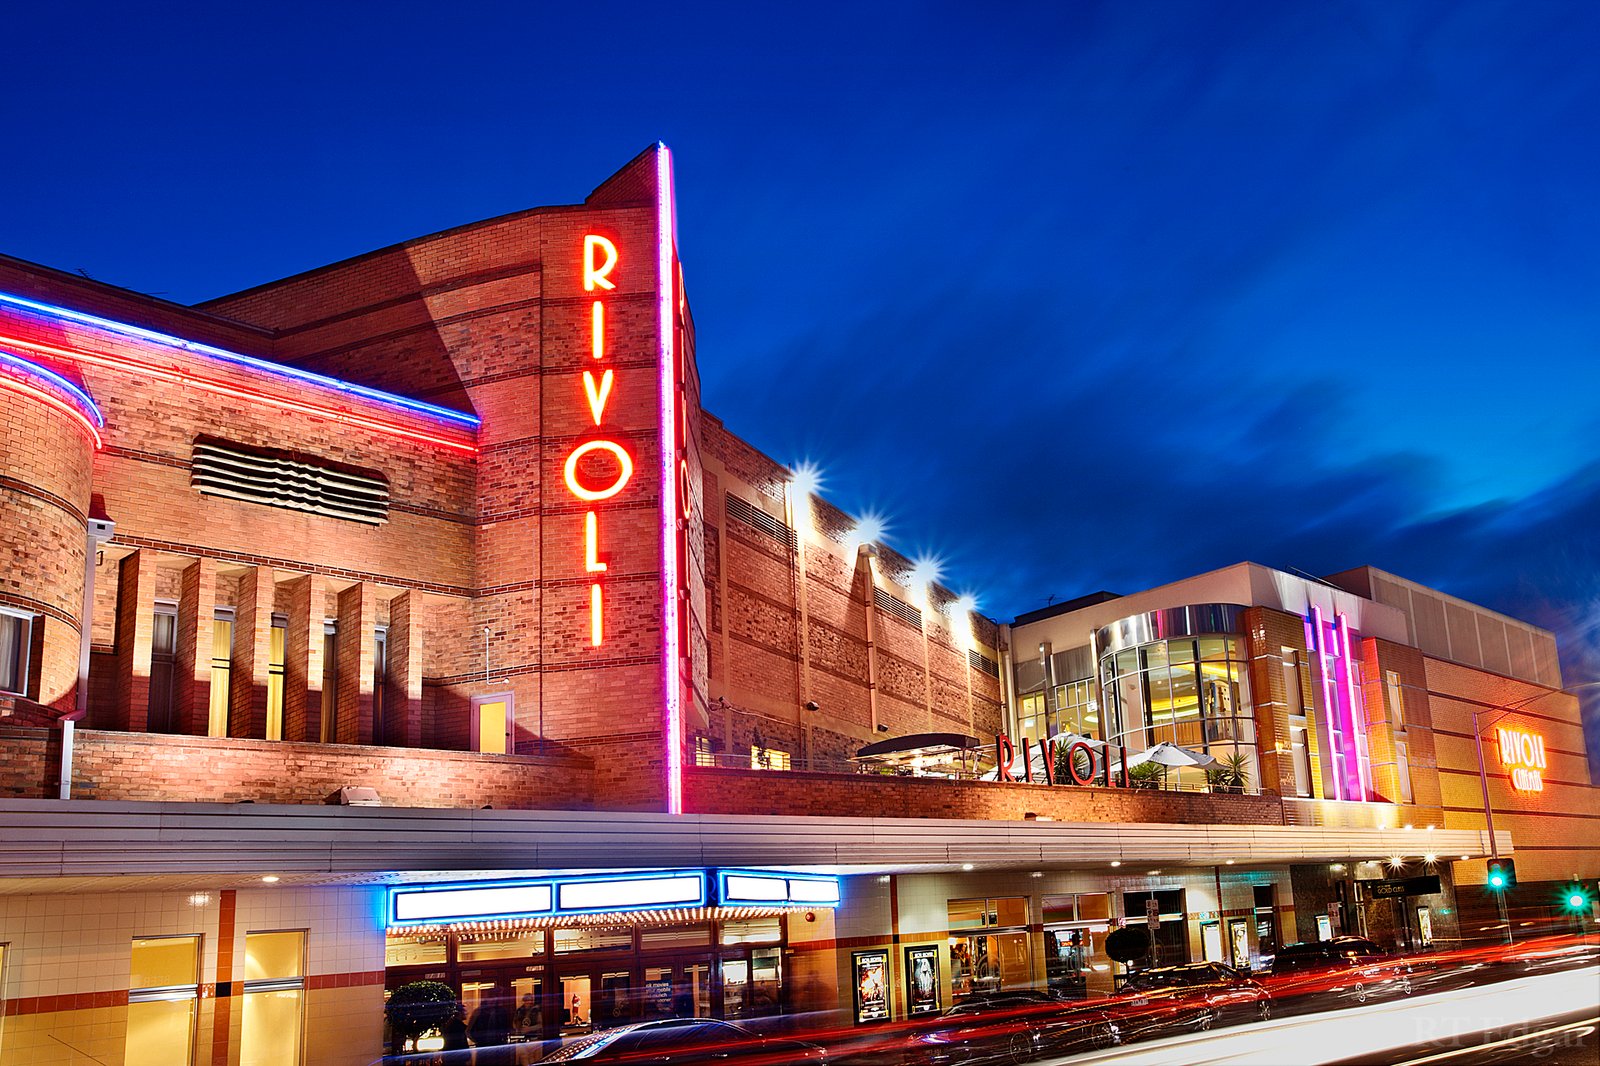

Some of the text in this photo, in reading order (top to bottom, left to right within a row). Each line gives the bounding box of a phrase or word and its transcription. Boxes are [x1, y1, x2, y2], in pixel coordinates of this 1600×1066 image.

[564, 234, 633, 647] RIVOLI
[995, 734, 1130, 788] RIVOLI
[1499, 728, 1547, 768] RIVOLI
